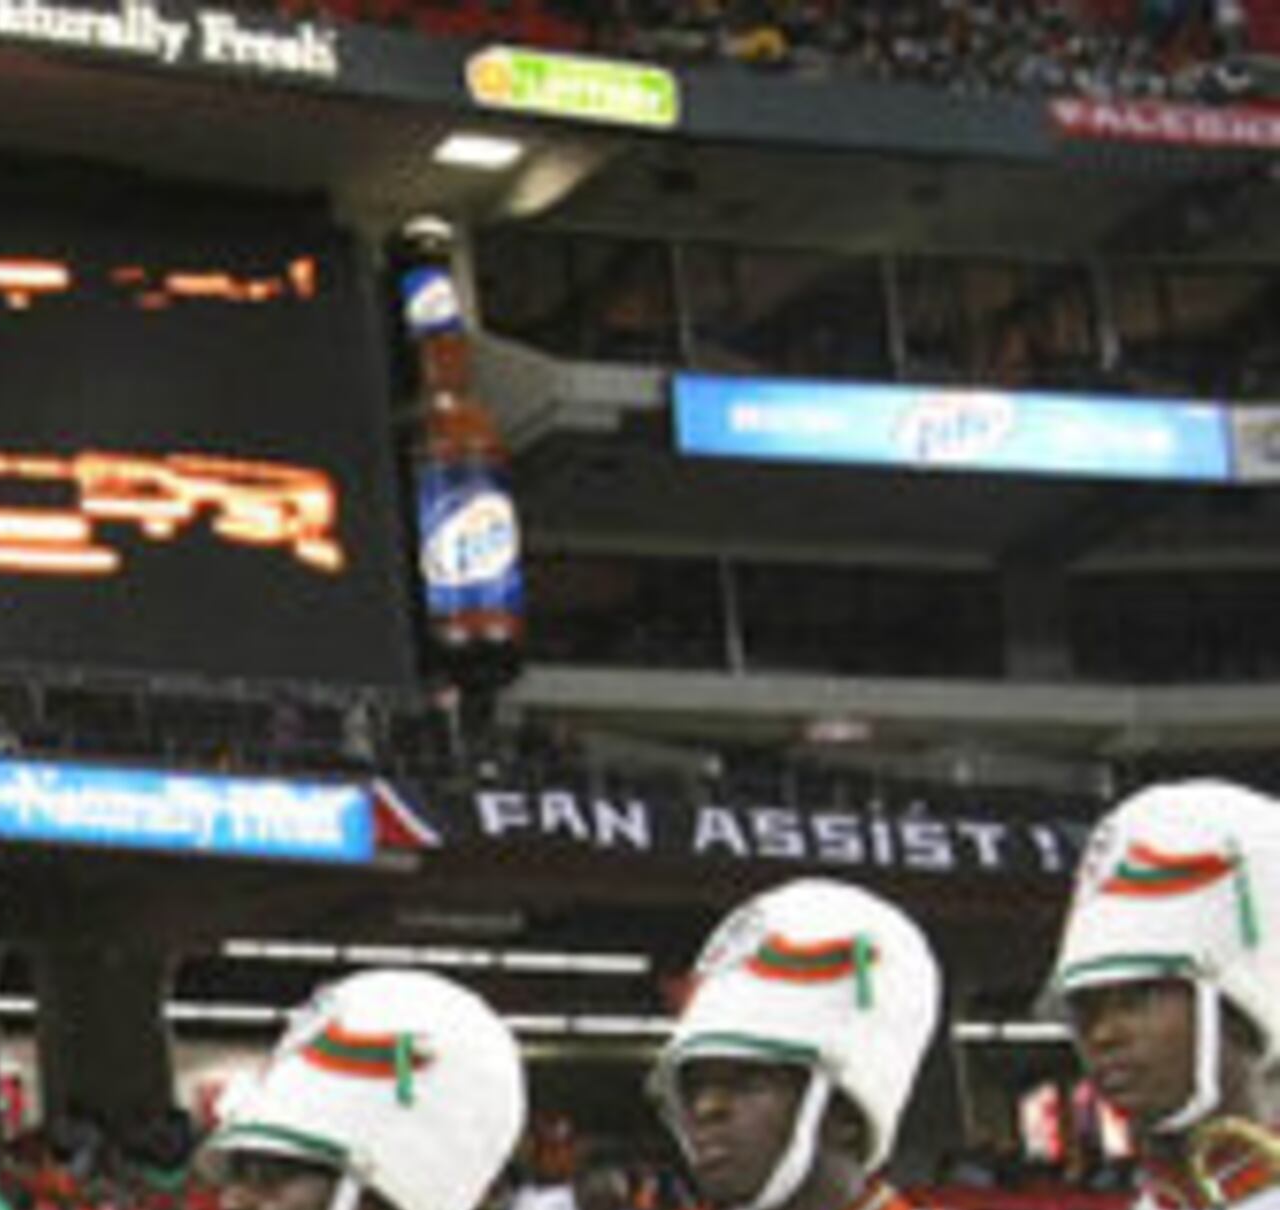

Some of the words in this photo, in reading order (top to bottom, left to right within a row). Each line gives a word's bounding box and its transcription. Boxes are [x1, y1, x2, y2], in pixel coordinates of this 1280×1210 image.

[197, 10, 338, 76] Fresh
[476, 789, 652, 848] FAN
[693, 807, 1006, 870] ASSIST
